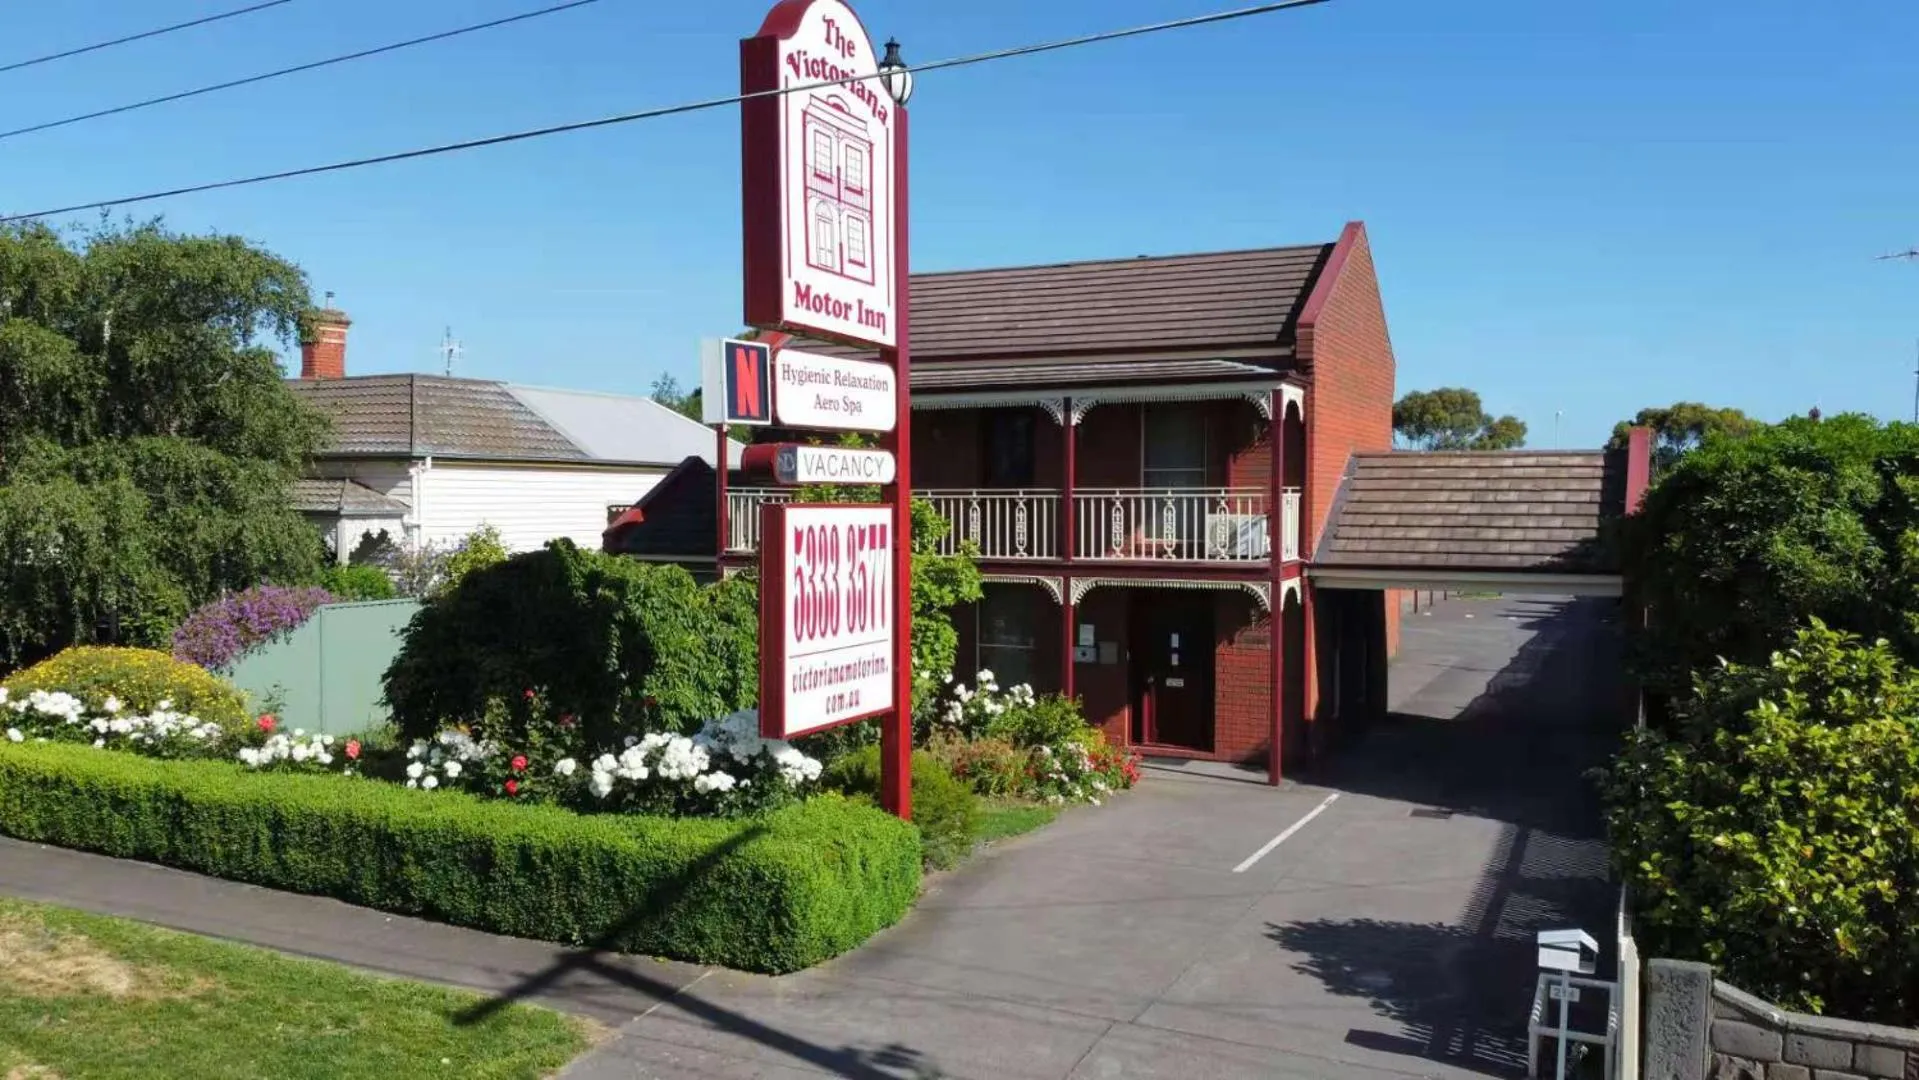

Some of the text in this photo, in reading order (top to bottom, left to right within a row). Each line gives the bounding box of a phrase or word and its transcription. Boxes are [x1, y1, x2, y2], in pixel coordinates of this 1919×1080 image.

[823, 14, 855, 58] The
[786, 50, 888, 126] Victoriana
[794, 280, 886, 336] Motor Inn
[735, 348, 760, 417] N
[782, 363, 889, 391] Hygienic Relaxation
[813, 393, 862, 416] Aero Spa
[803, 453, 885, 478] VACANCY
[794, 523, 887, 643] 5333 3577
[826, 688, 860, 715] com.au
